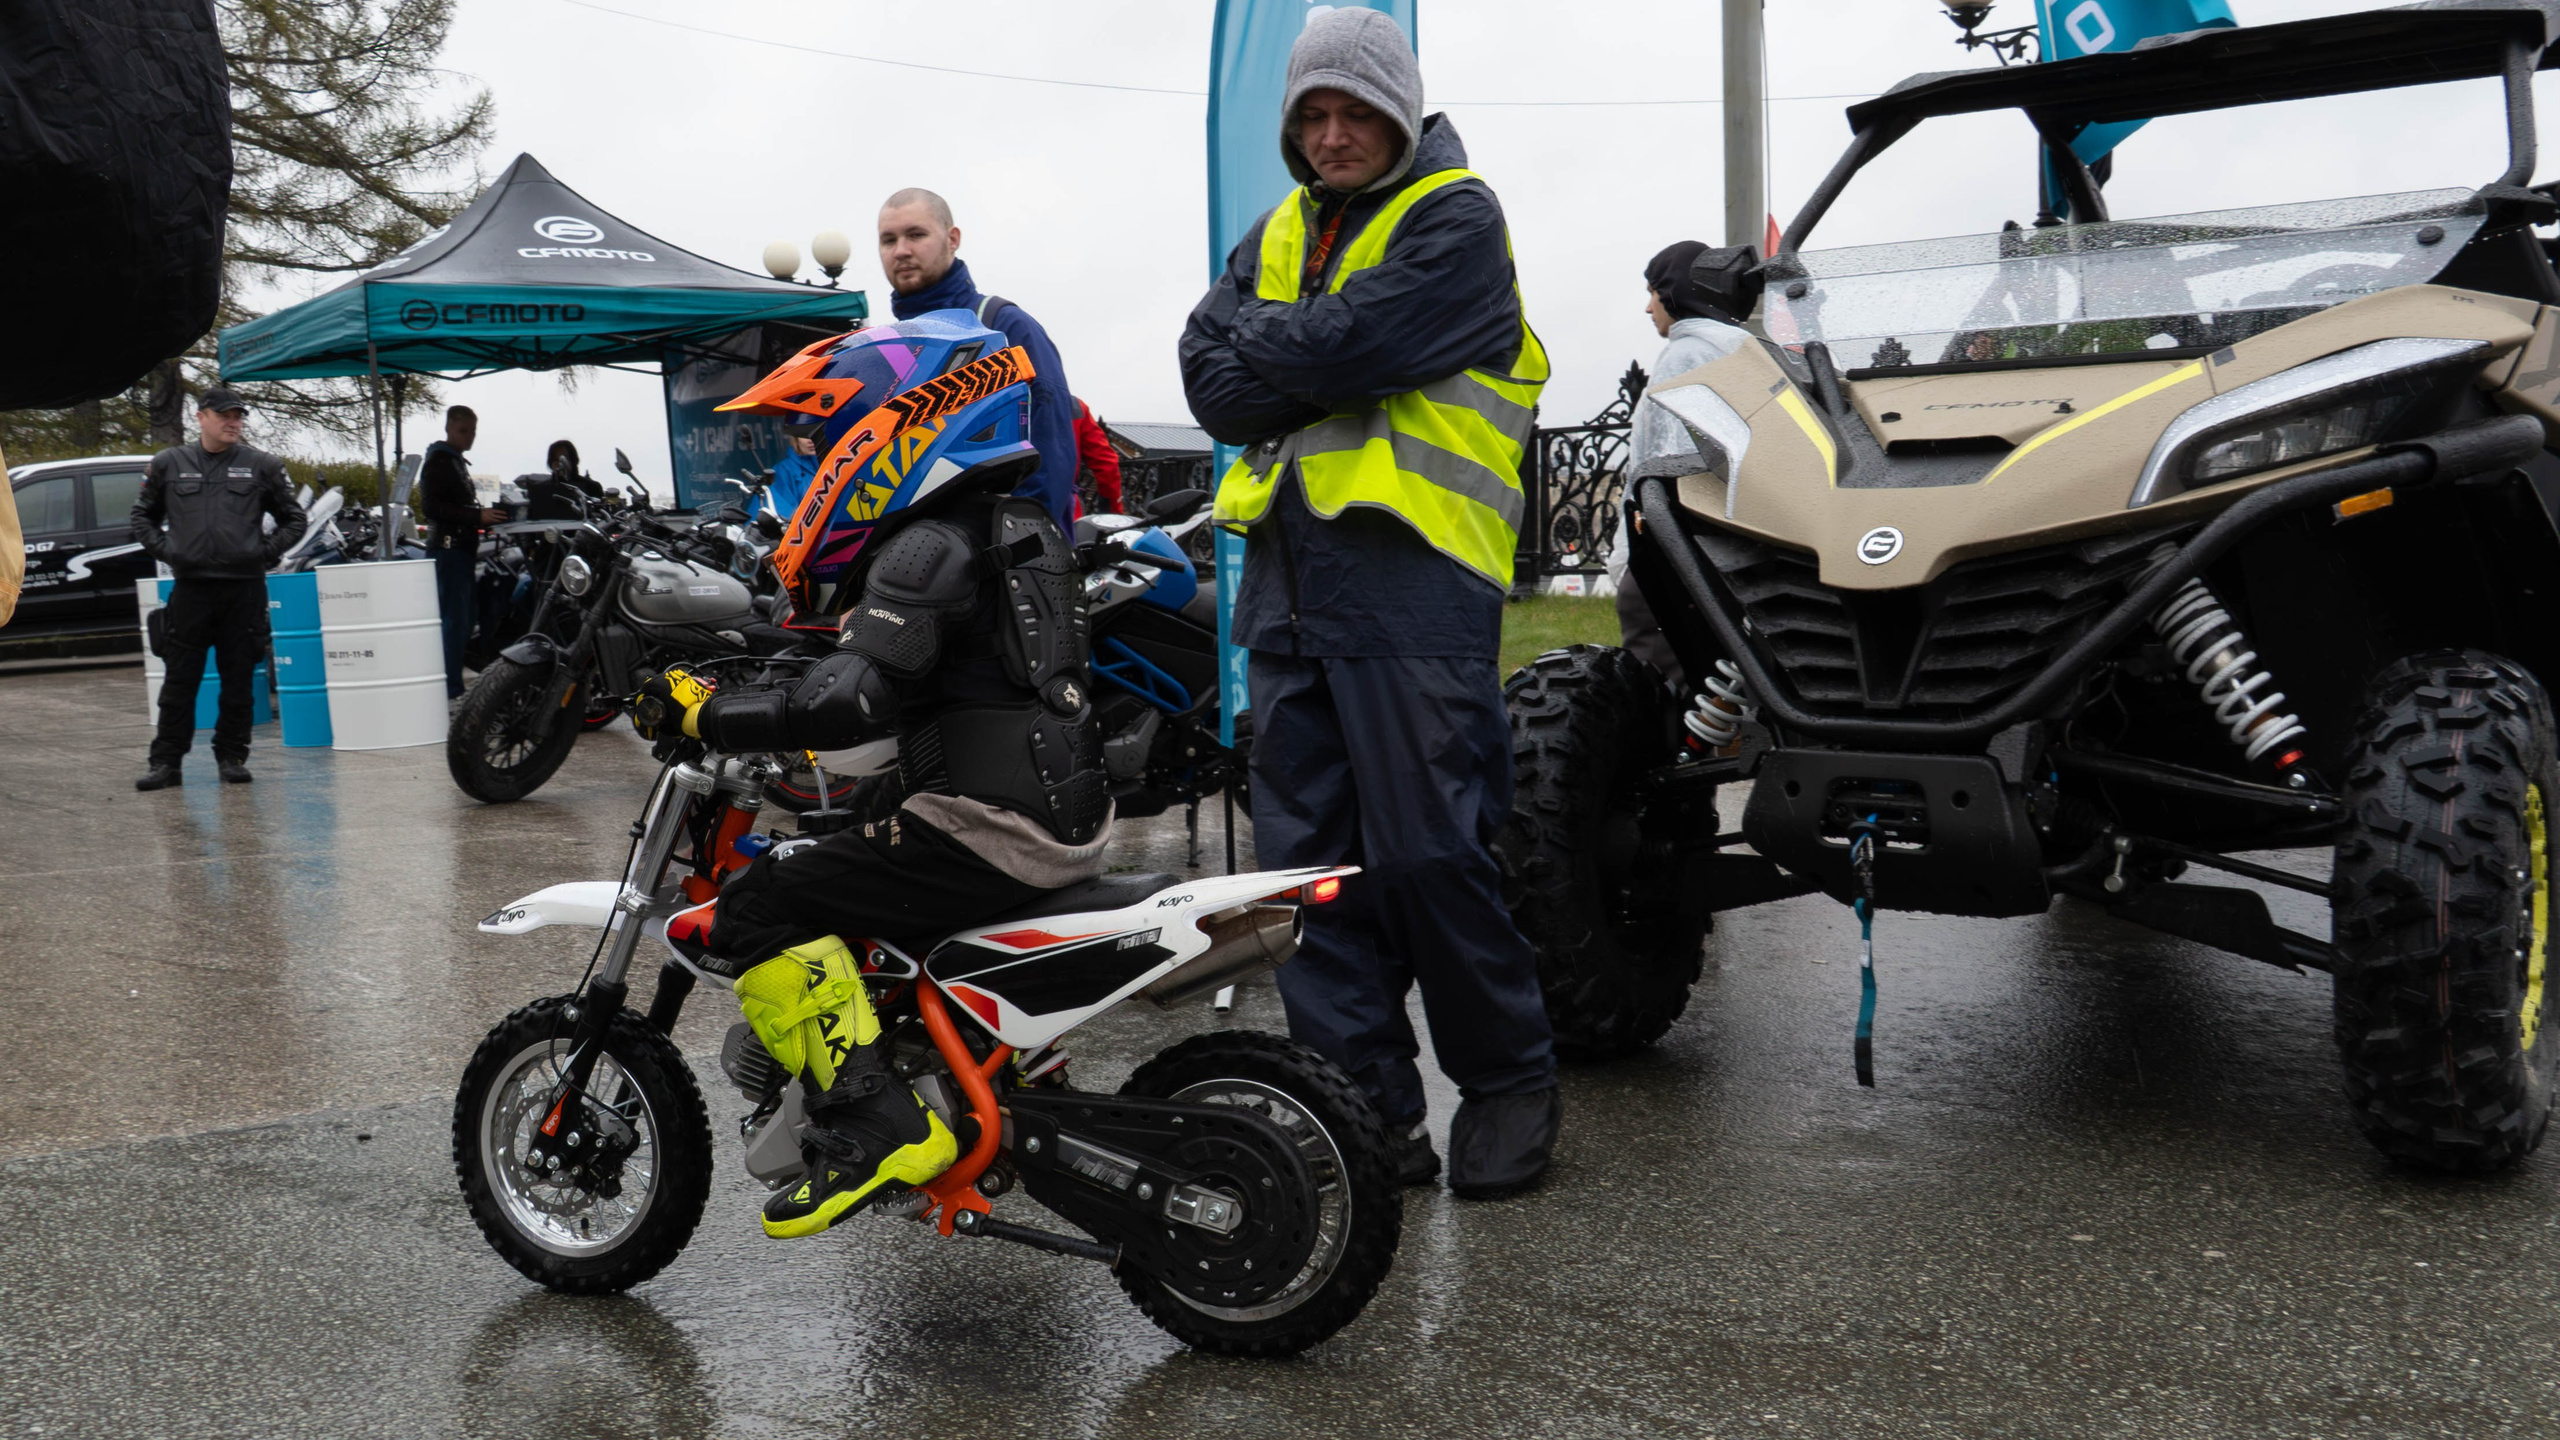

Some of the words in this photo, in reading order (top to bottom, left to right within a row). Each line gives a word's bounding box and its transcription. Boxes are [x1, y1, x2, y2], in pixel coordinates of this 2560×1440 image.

[517, 248, 656, 262] CFMOTO
[442, 303, 585, 324] CFMOTO
[788, 428, 879, 546] VEMAR
[868, 608, 906, 626] HUNTING
[1157, 894, 1194, 908] KAYO
